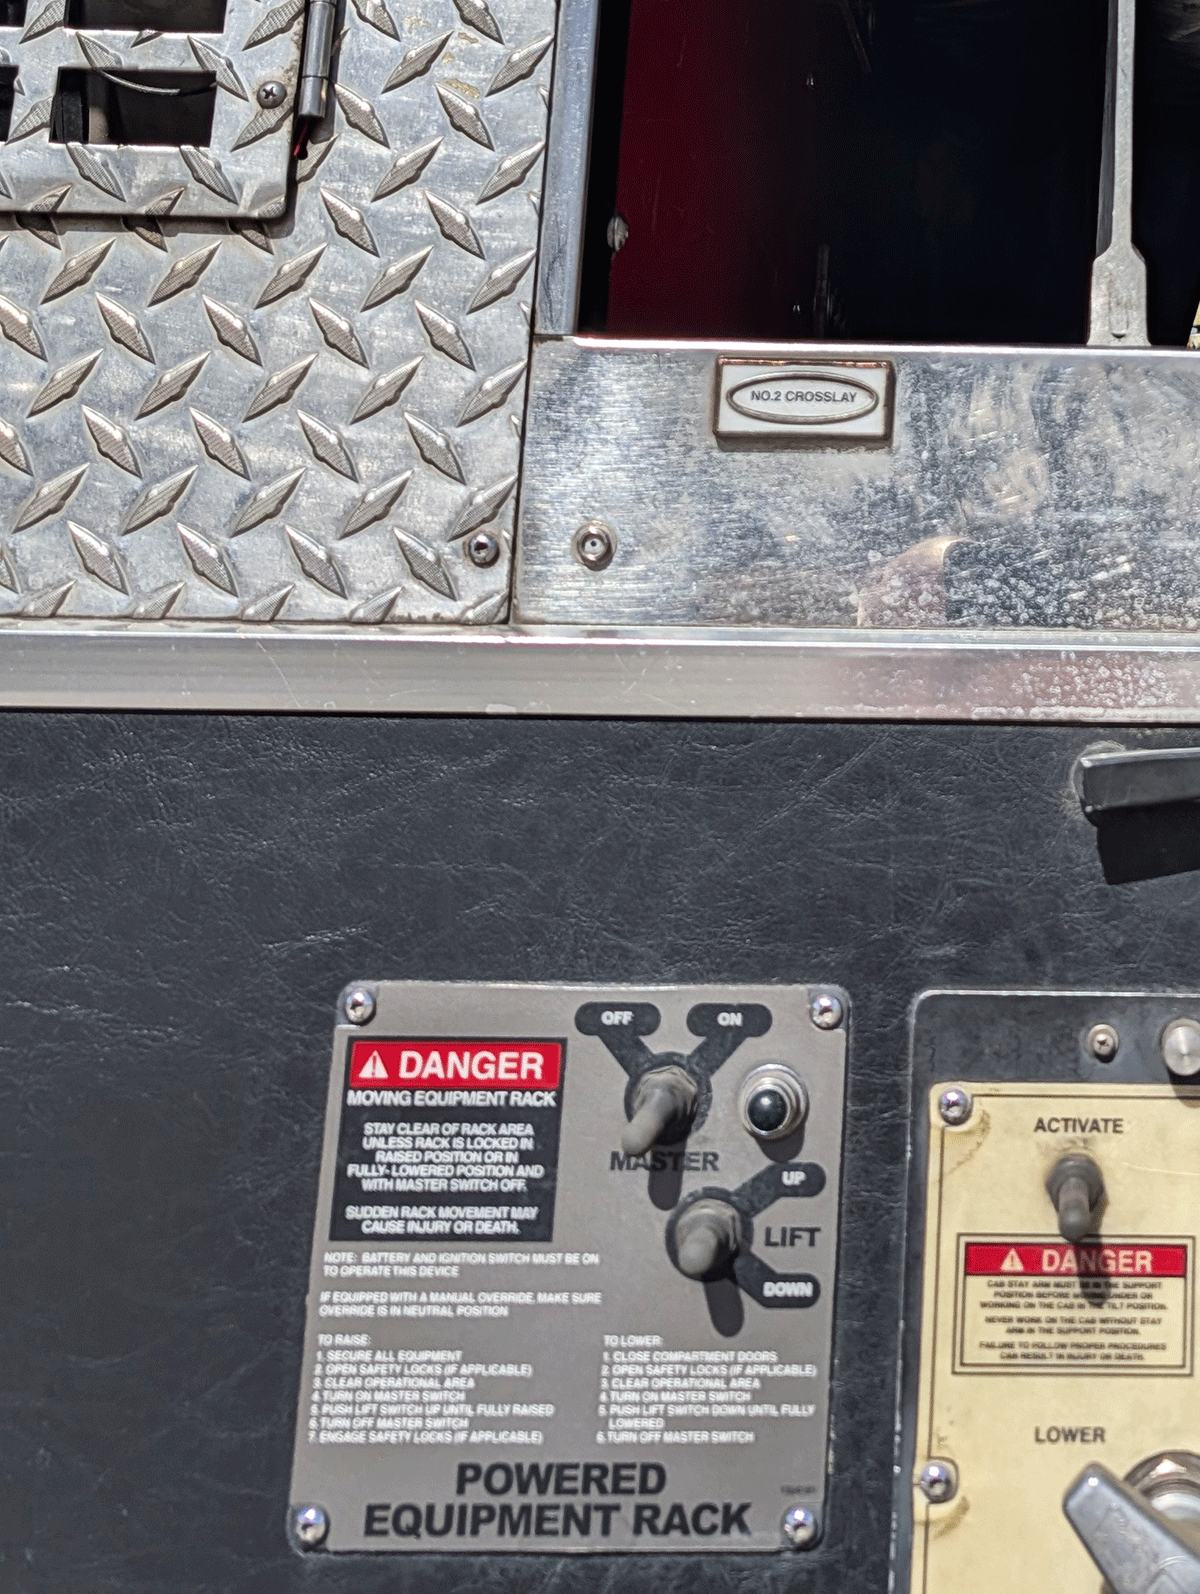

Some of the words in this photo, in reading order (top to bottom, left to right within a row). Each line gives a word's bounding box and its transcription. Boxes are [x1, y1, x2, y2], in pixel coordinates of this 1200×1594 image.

[750, 390, 782, 402] NO.2
[785, 390, 858, 403] CROSSLAY
[601, 1011, 632, 1025] OFF
[716, 1011, 743, 1026] ON
[399, 1050, 544, 1080] DANGER
[347, 1090, 411, 1106] MOVING
[414, 1090, 508, 1107] EQUIPMENT
[509, 1091, 557, 1107] RACK
[363, 1122, 394, 1135] STAY
[397, 1122, 440, 1135] CLEAR
[441, 1123, 460, 1135] OF
[461, 1123, 497, 1136] RACK
[499, 1123, 535, 1136] AREA
[1034, 1118, 1124, 1135] ACTIVATE
[362, 1136, 413, 1149] UNLESS
[415, 1137, 450, 1150] RACK
[452, 1137, 464, 1150] IS
[466, 1137, 518, 1150] LOCKED
[520, 1138, 534, 1150] IN
[375, 1151, 422, 1163] RAISED
[424, 1151, 482, 1163] POSITION
[484, 1151, 503, 1163] OR
[505, 1151, 519, 1164] IN
[610, 1151, 719, 1171] MASTER
[391, 1164, 454, 1177] LOWERED
[456, 1164, 514, 1178] POSITION
[516, 1165, 545, 1178] AND
[362, 1178, 393, 1191] WITH
[396, 1178, 448, 1192] MASTER
[449, 1179, 498, 1192] SWITCH
[500, 1179, 528, 1192] OFF.
[782, 1172, 805, 1185] UP
[345, 1206, 399, 1219] SUDDEN
[401, 1206, 437, 1219] RACK
[438, 1206, 509, 1220] MOVEMENT
[511, 1206, 539, 1220] MAY
[362, 1220, 405, 1234] CAUSE
[407, 1220, 451, 1234] INJURY
[453, 1221, 473, 1234] OR
[476, 1221, 520, 1234] DEATH.
[764, 1228, 821, 1248] LIFT
[362, 1252, 410, 1264] BATTERY
[413, 1252, 437, 1264] AND
[439, 1253, 485, 1265] IGNITION
[488, 1253, 530, 1265] SWITCH
[532, 1253, 564, 1265] MUST
[565, 1253, 580, 1265] BE
[582, 1253, 600, 1265] ON
[1042, 1249, 1153, 1272] DANGER
[323, 1266, 338, 1277] TO
[340, 1266, 391, 1277] OPERATE
[393, 1266, 417, 1278] THIS
[419, 1266, 459, 1278] DEVICE
[762, 1282, 813, 1297] DOWN
[320, 1292, 330, 1303] IF
[333, 1292, 388, 1303] EQUIPPED
[390, 1292, 417, 1303] WITH
[430, 1292, 476, 1303] MANUAL
[537, 1292, 570, 1304] MAKE
[572, 1293, 602, 1304] SURE
[319, 1305, 375, 1316] OVERRIDE
[377, 1305, 388, 1316] IS
[390, 1305, 401, 1316] IN
[403, 1305, 454, 1317] NEUTRAL
[456, 1305, 509, 1317] POSITION
[317, 1334, 332, 1345] TO
[604, 1335, 618, 1346] TO
[327, 1350, 372, 1362] SECURE
[374, 1350, 395, 1362] ALL
[398, 1350, 462, 1362] EQUIPMENT
[613, 1351, 650, 1363] CLOSE
[653, 1351, 735, 1363] COMPARTMENT
[738, 1351, 778, 1363] DOORS
[326, 1364, 357, 1375] OPEN
[359, 1364, 402, 1375] SAFETY
[404, 1364, 442, 1376] LOCKS
[612, 1364, 643, 1376] OPEN
[645, 1364, 688, 1376] SAFETY
[690, 1365, 728, 1376] LOCKS
[324, 1377, 362, 1389] CLEAR
[364, 1377, 441, 1389] OPERATIONAL
[444, 1378, 475, 1389] AREA
[612, 1378, 649, 1389] CLEAR
[651, 1378, 727, 1389] OPERATIONAL
[729, 1378, 761, 1389] AREA
[322, 1404, 353, 1415] PUSH
[355, 1404, 377, 1416] LIFT
[380, 1404, 423, 1416] SWITCH
[425, 1404, 440, 1416] UP
[443, 1404, 474, 1416] UNTIL
[476, 1404, 510, 1416] FULLY
[512, 1404, 555, 1416] RAISED
[609, 1405, 640, 1416] PUSH
[642, 1405, 665, 1416] LIFT
[667, 1405, 710, 1416] SWITCH
[712, 1405, 745, 1416] DOWN
[747, 1404, 778, 1416] UNTIL
[781, 1404, 815, 1416] FULLY
[608, 1418, 664, 1429] LOWERED
[319, 1431, 367, 1443] ENGAGE
[369, 1431, 411, 1443] SAFETY
[413, 1431, 452, 1443] LOCKS
[1035, 1426, 1106, 1443] LOWER
[456, 1462, 667, 1495] POWERED
[363, 1503, 620, 1538] EQUIPMENT
[632, 1503, 752, 1538] RACK
